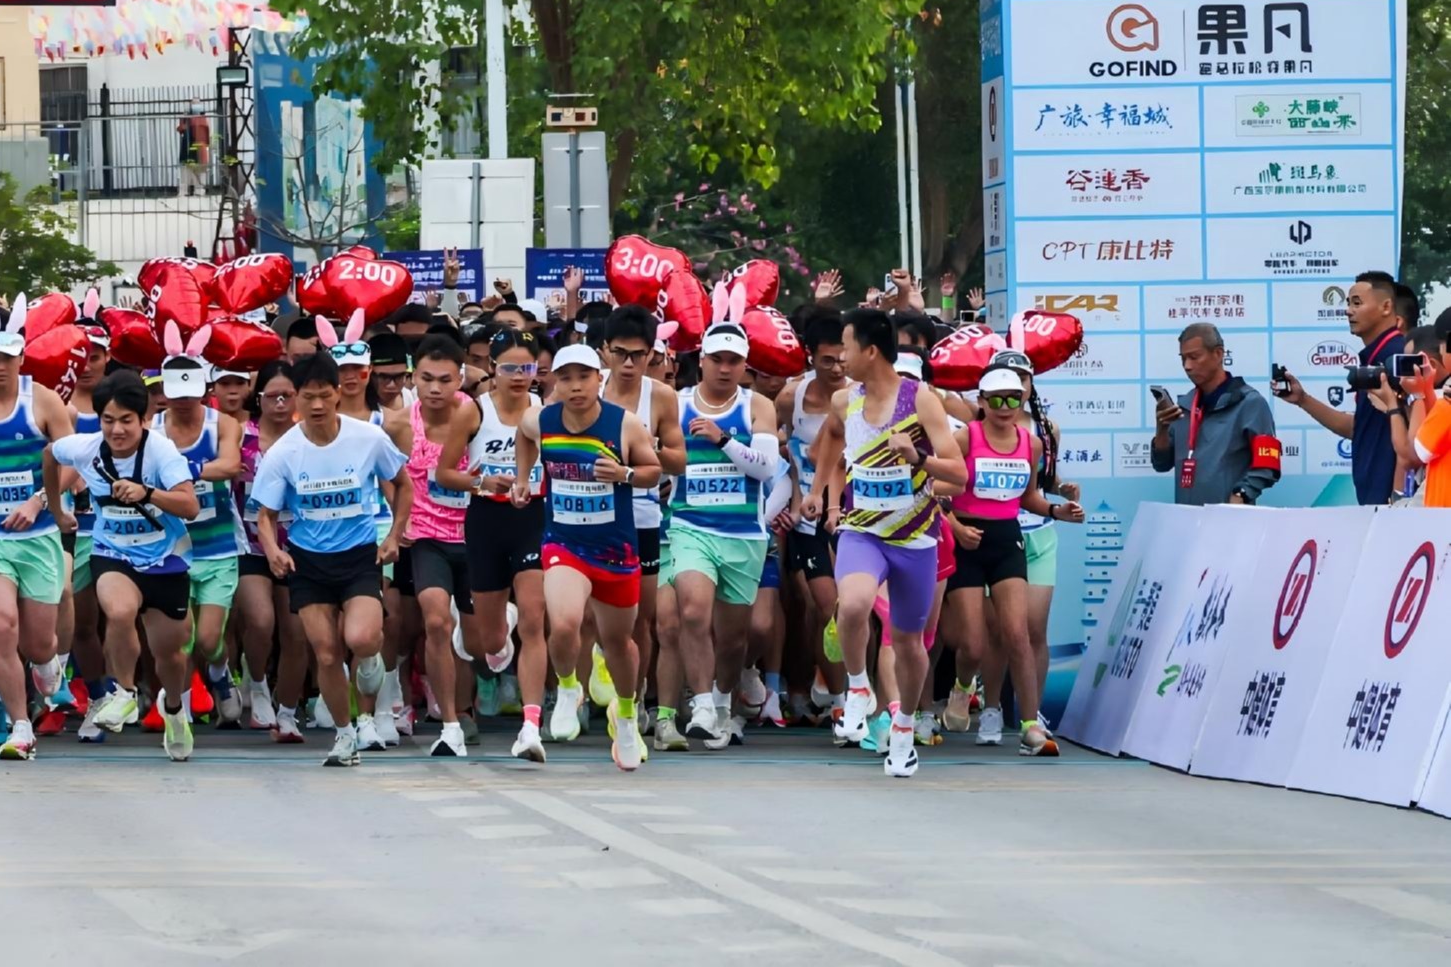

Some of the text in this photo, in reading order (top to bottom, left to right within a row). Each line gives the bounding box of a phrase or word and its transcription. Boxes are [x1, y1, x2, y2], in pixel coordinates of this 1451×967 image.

[1089, 60, 1178, 77] GOFIND
[1042, 239, 1175, 261] CPT 康比特
[615, 246, 675, 282] 3:00
[338, 260, 397, 287] 2:00
[687, 478, 740, 493] A0522
[976, 470, 1026, 489] A1079
[301, 491, 355, 509] A0902
[553, 494, 609, 512] A0816
